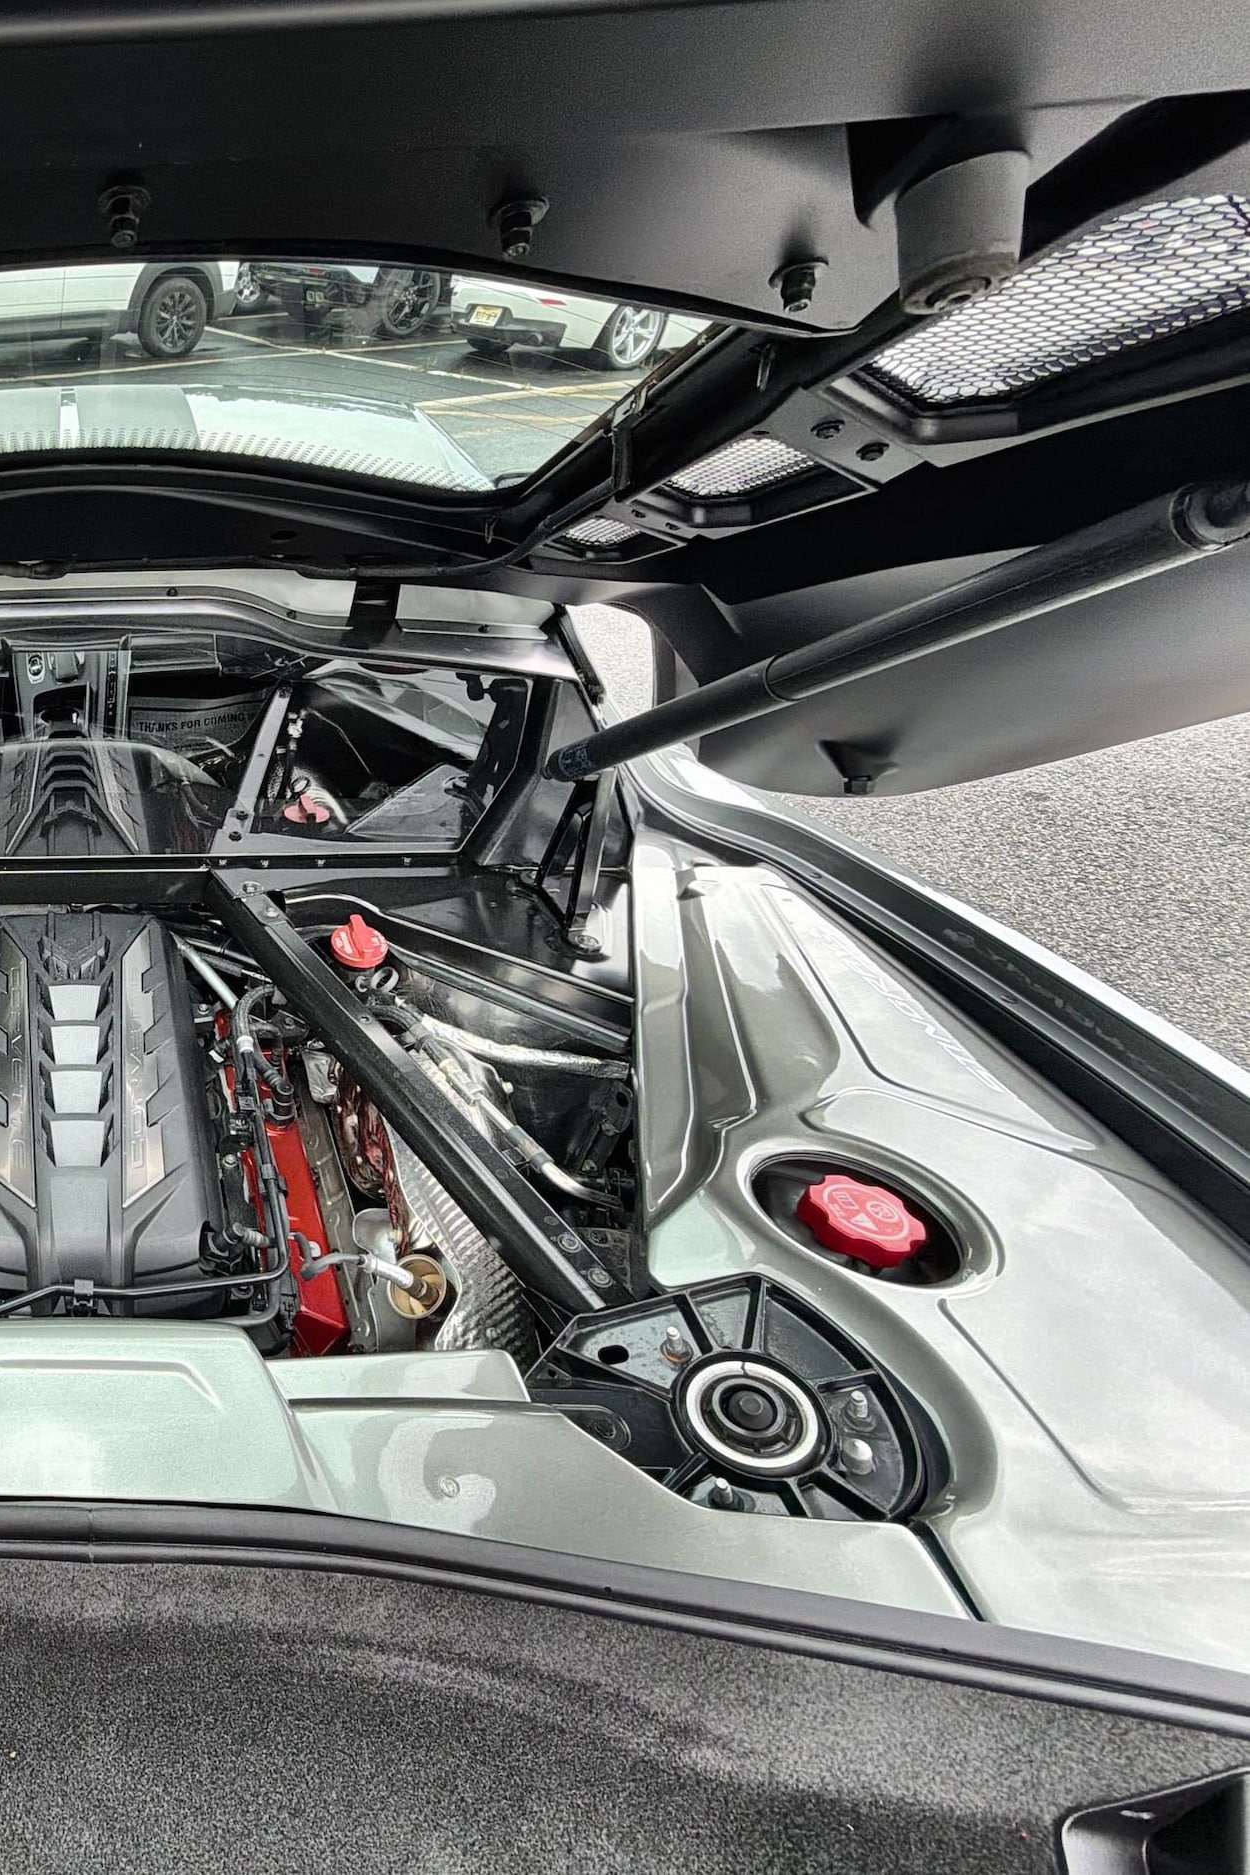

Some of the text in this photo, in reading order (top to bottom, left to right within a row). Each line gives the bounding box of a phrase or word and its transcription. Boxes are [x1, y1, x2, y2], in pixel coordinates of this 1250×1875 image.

[139, 722, 178, 732] THANKS
[181, 720, 201, 730] FOR
[204, 713, 245, 726] COMING
[10, 966, 25, 1169] CORVETTE
